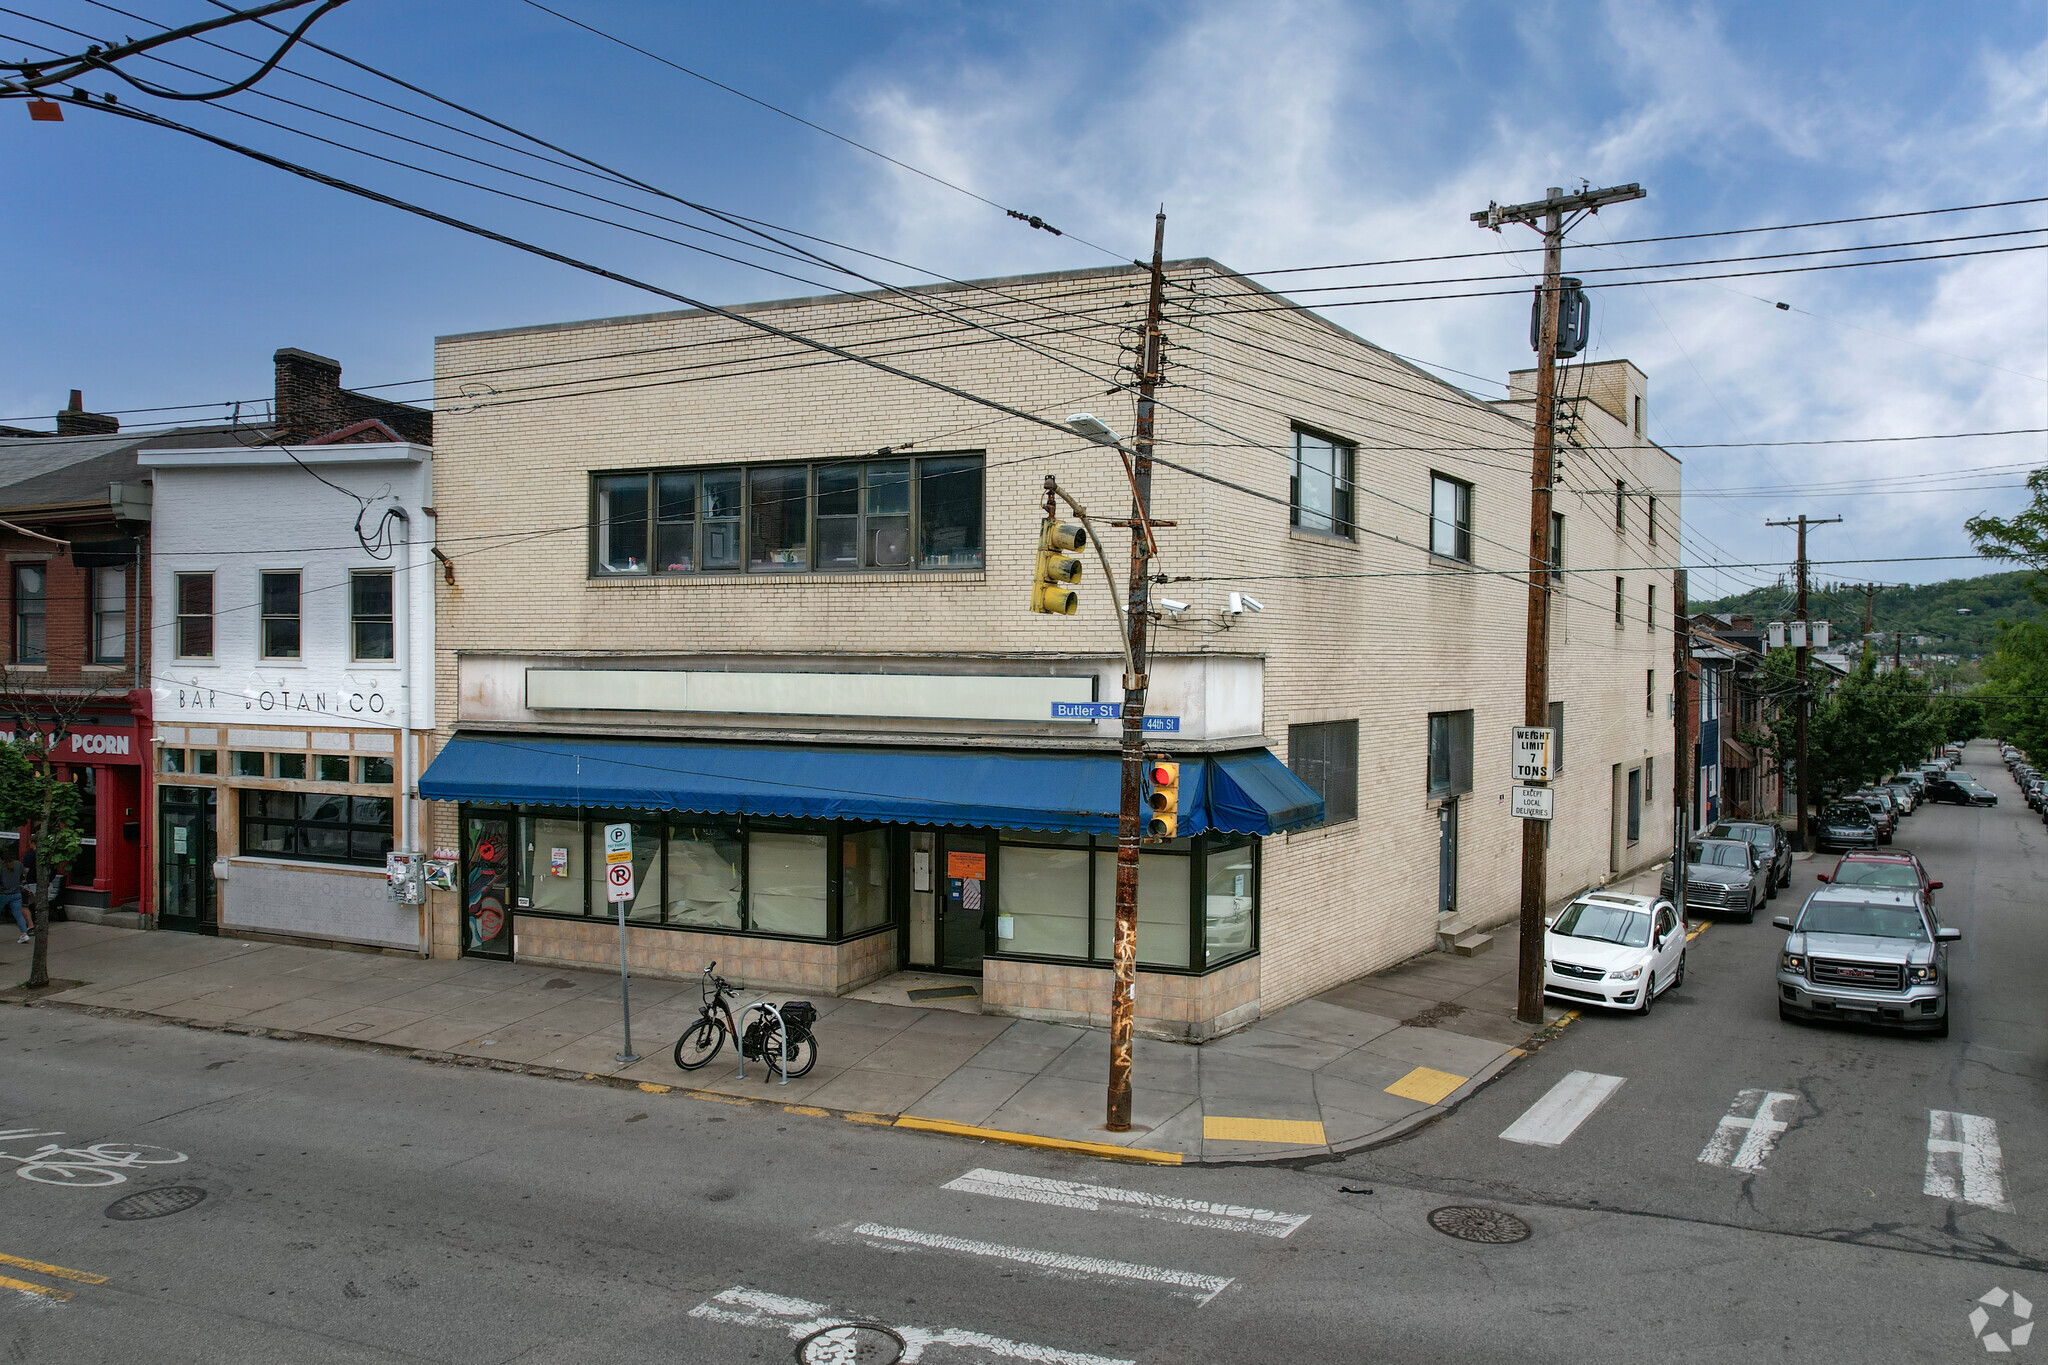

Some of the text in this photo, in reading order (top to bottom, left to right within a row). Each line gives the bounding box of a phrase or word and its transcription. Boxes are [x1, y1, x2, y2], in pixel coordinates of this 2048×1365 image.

[179, 689, 216, 709] BAR
[1058, 704, 1114, 717] Butler St
[1147, 719, 1175, 730] 44th St
[1517, 731, 1550, 740] WEIGHT
[1521, 741, 1545, 750] LIMIT
[1530, 753, 1536, 763] 7
[1518, 765, 1547, 776] TONS
[1522, 789, 1543, 798] EXCEPT
[1523, 799, 1541, 807] LOCAL
[1515, 807, 1549, 816] DELIVERIES
[615, 831, 622, 840] P
[1837, 967, 1874, 978] GMC
